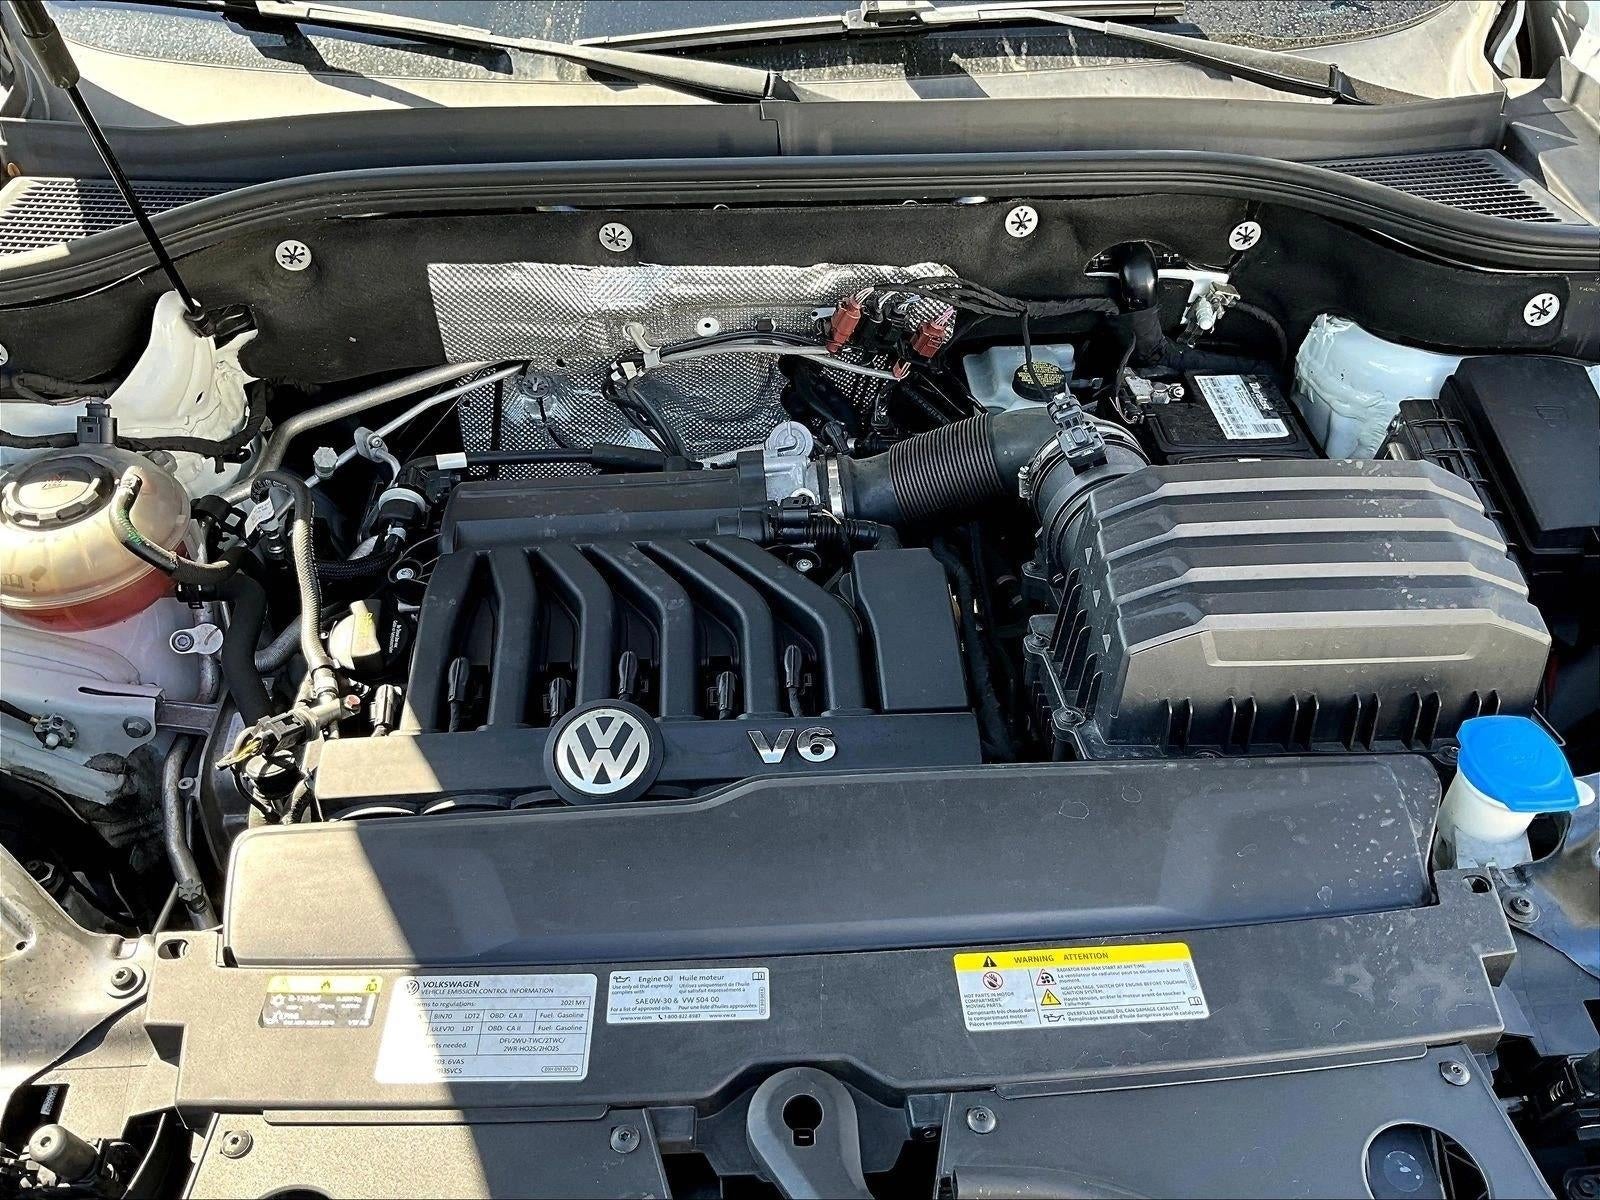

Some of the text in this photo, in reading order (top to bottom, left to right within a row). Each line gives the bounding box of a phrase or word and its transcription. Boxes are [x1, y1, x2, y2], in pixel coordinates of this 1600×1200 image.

[747, 727, 837, 764] V6
[1014, 952, 1109, 964] WARNING ATTENTION
[423, 980, 480, 988] VOLKSWAGEN
[638, 976, 662, 984] Engine
